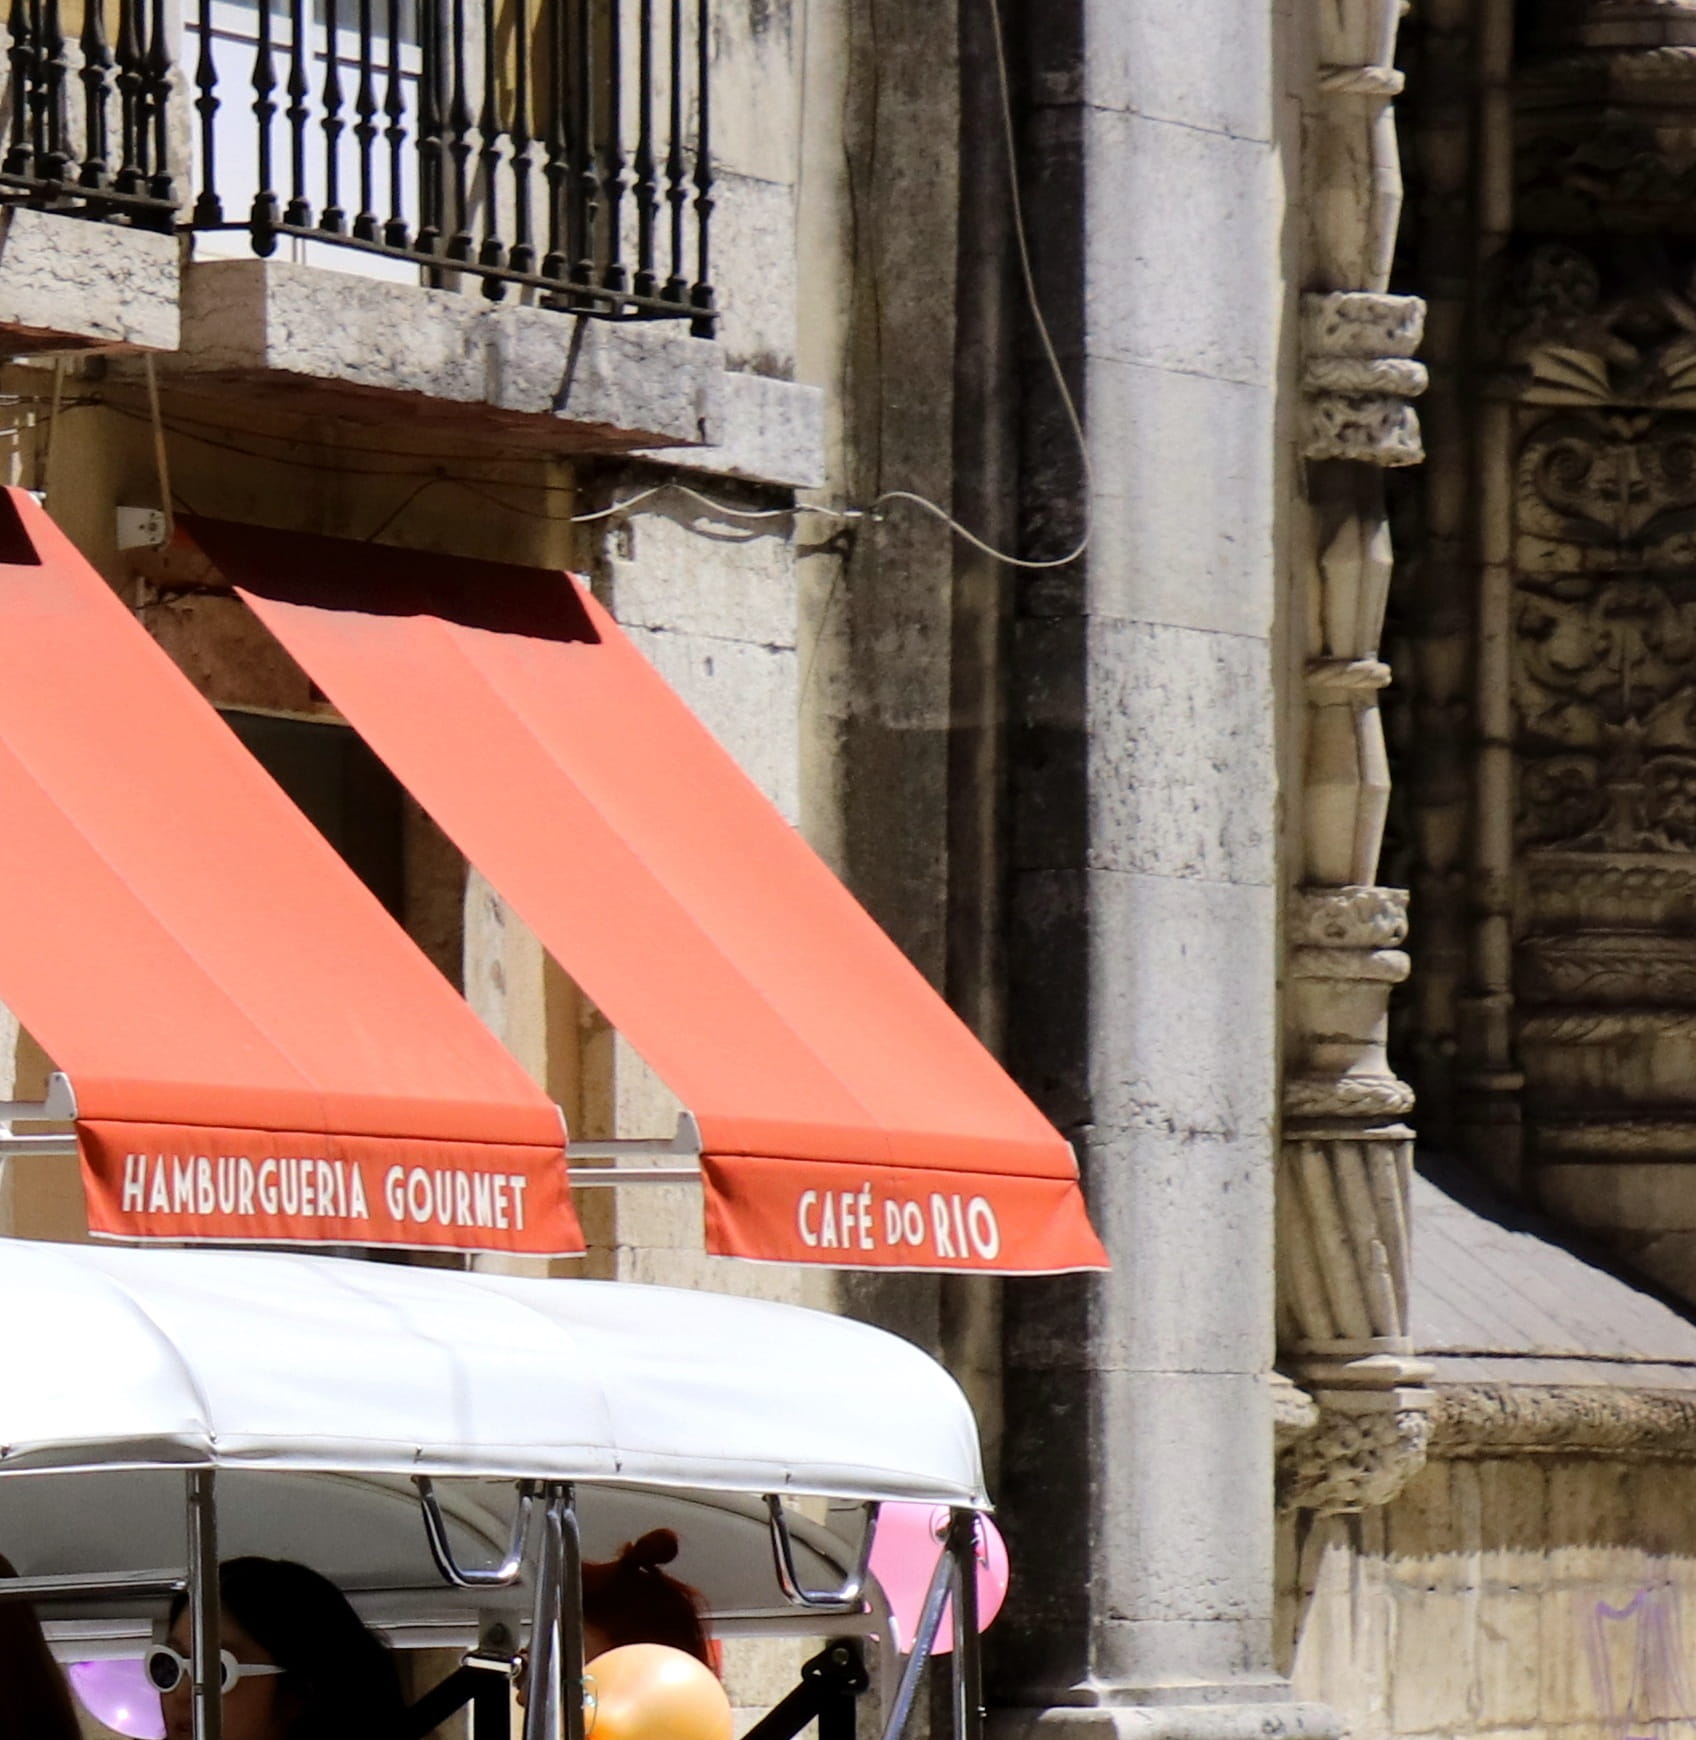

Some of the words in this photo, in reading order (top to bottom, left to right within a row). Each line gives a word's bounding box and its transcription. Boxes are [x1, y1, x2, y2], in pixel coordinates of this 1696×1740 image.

[121, 1154, 369, 1220] HAMBURGUERIA
[384, 1164, 528, 1231] GOURMET
[798, 1181, 875, 1251] CAFÉ
[930, 1193, 1001, 1261] RIO
